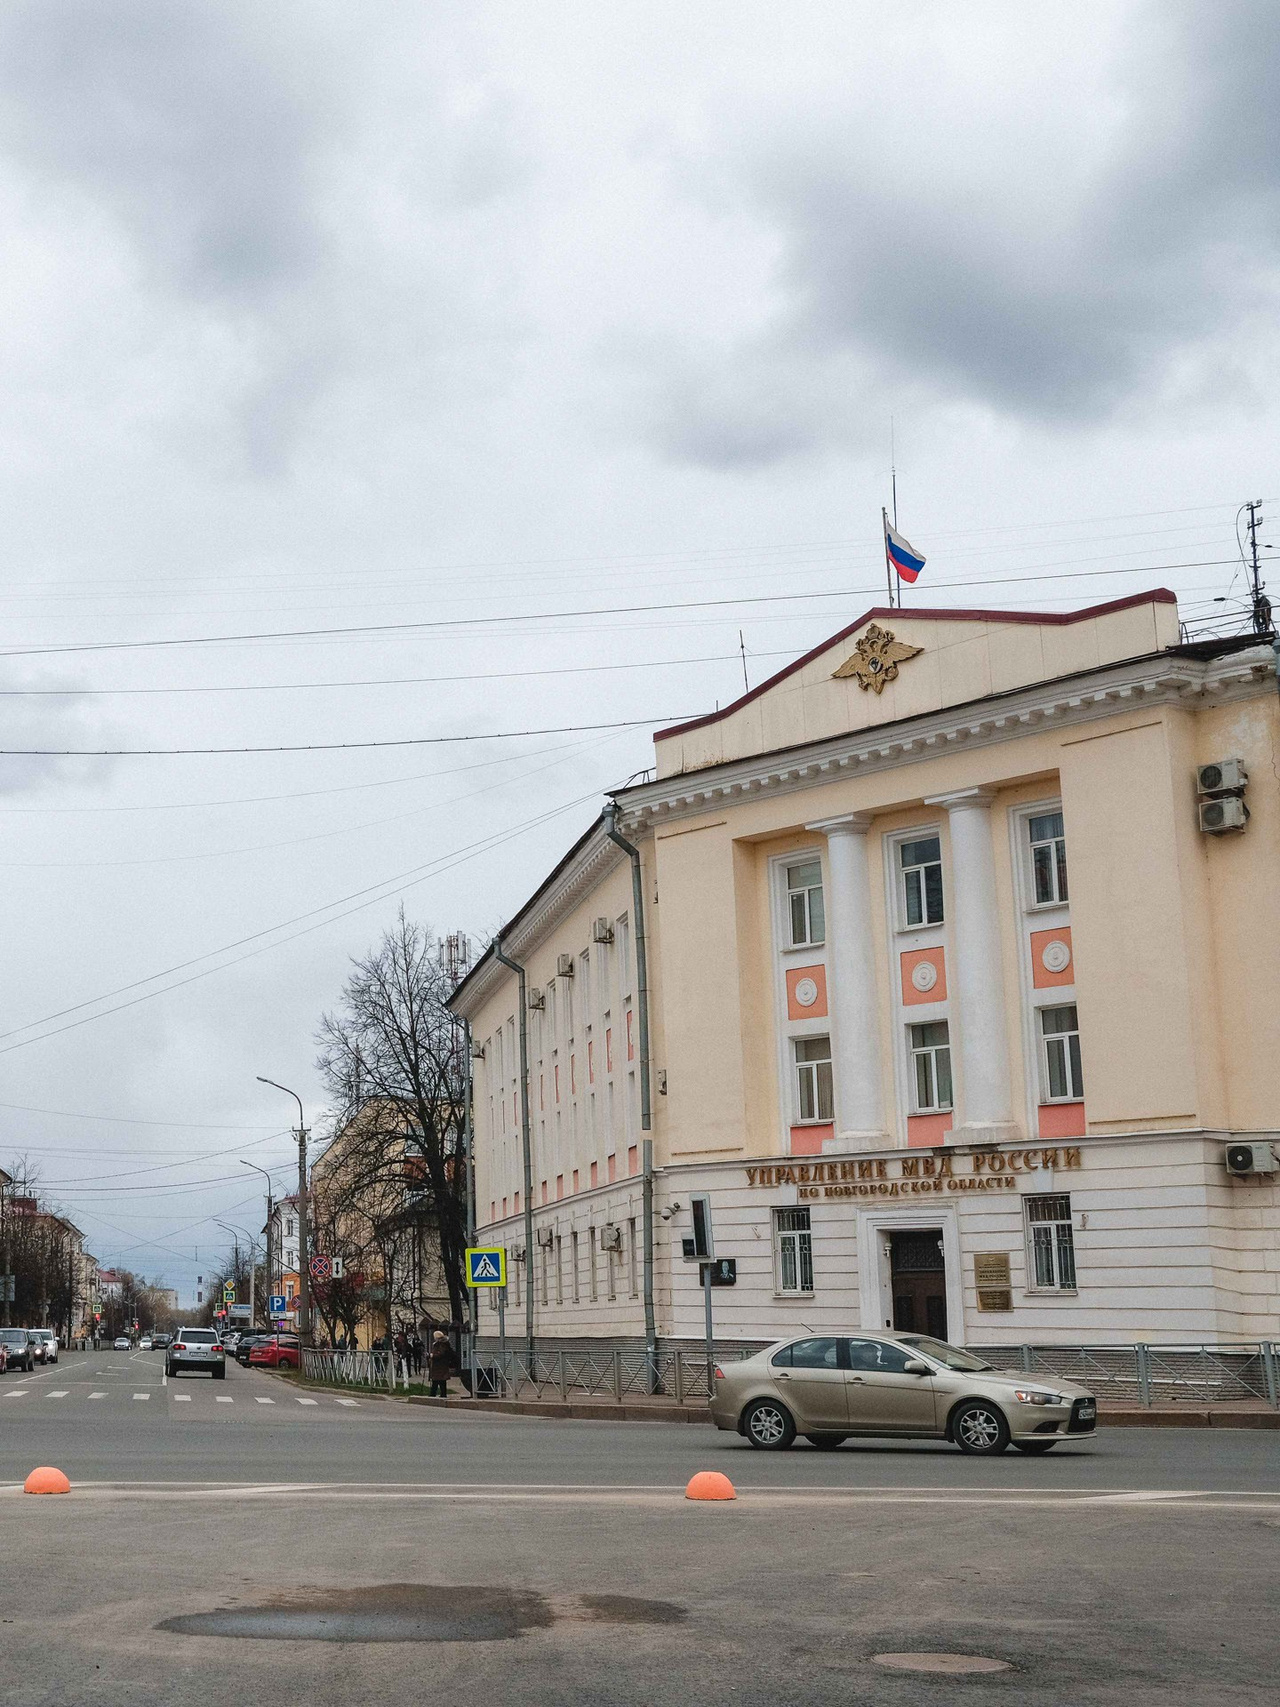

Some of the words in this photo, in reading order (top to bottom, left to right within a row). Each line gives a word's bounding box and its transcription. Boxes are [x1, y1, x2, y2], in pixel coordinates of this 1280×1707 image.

[745, 1159, 888, 1186] УПРАВЛЕНИЕ
[901, 1155, 952, 1179] МВД
[972, 1146, 1081, 1173] РОССИИ
[824, 1177, 943, 1198] НОВГОРОДСКОЙ
[947, 1176, 1016, 1191] ОБЛАСТИ
